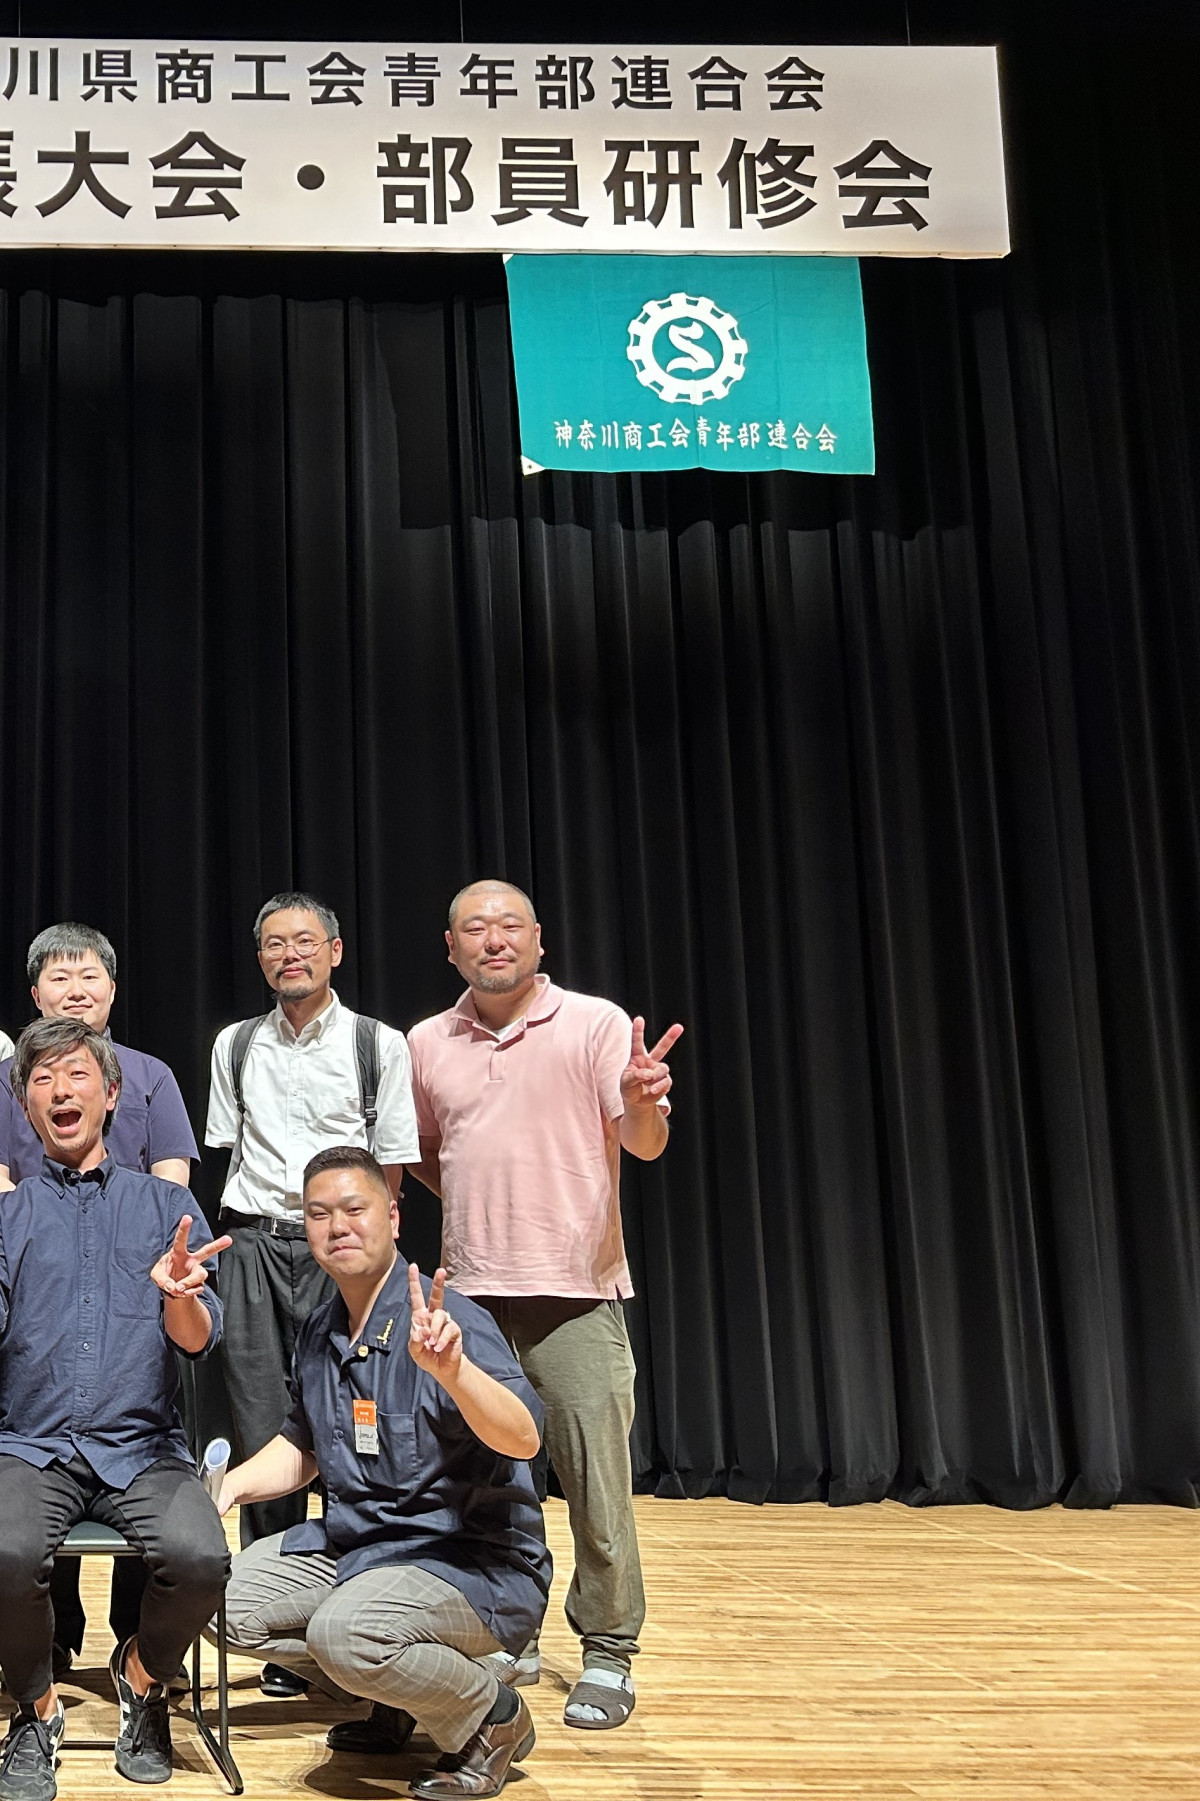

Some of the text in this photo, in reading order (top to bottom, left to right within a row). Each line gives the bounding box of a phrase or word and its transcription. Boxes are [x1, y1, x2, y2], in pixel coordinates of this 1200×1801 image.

[554, 415, 838, 454] 神奈川商工会青年部連合会
